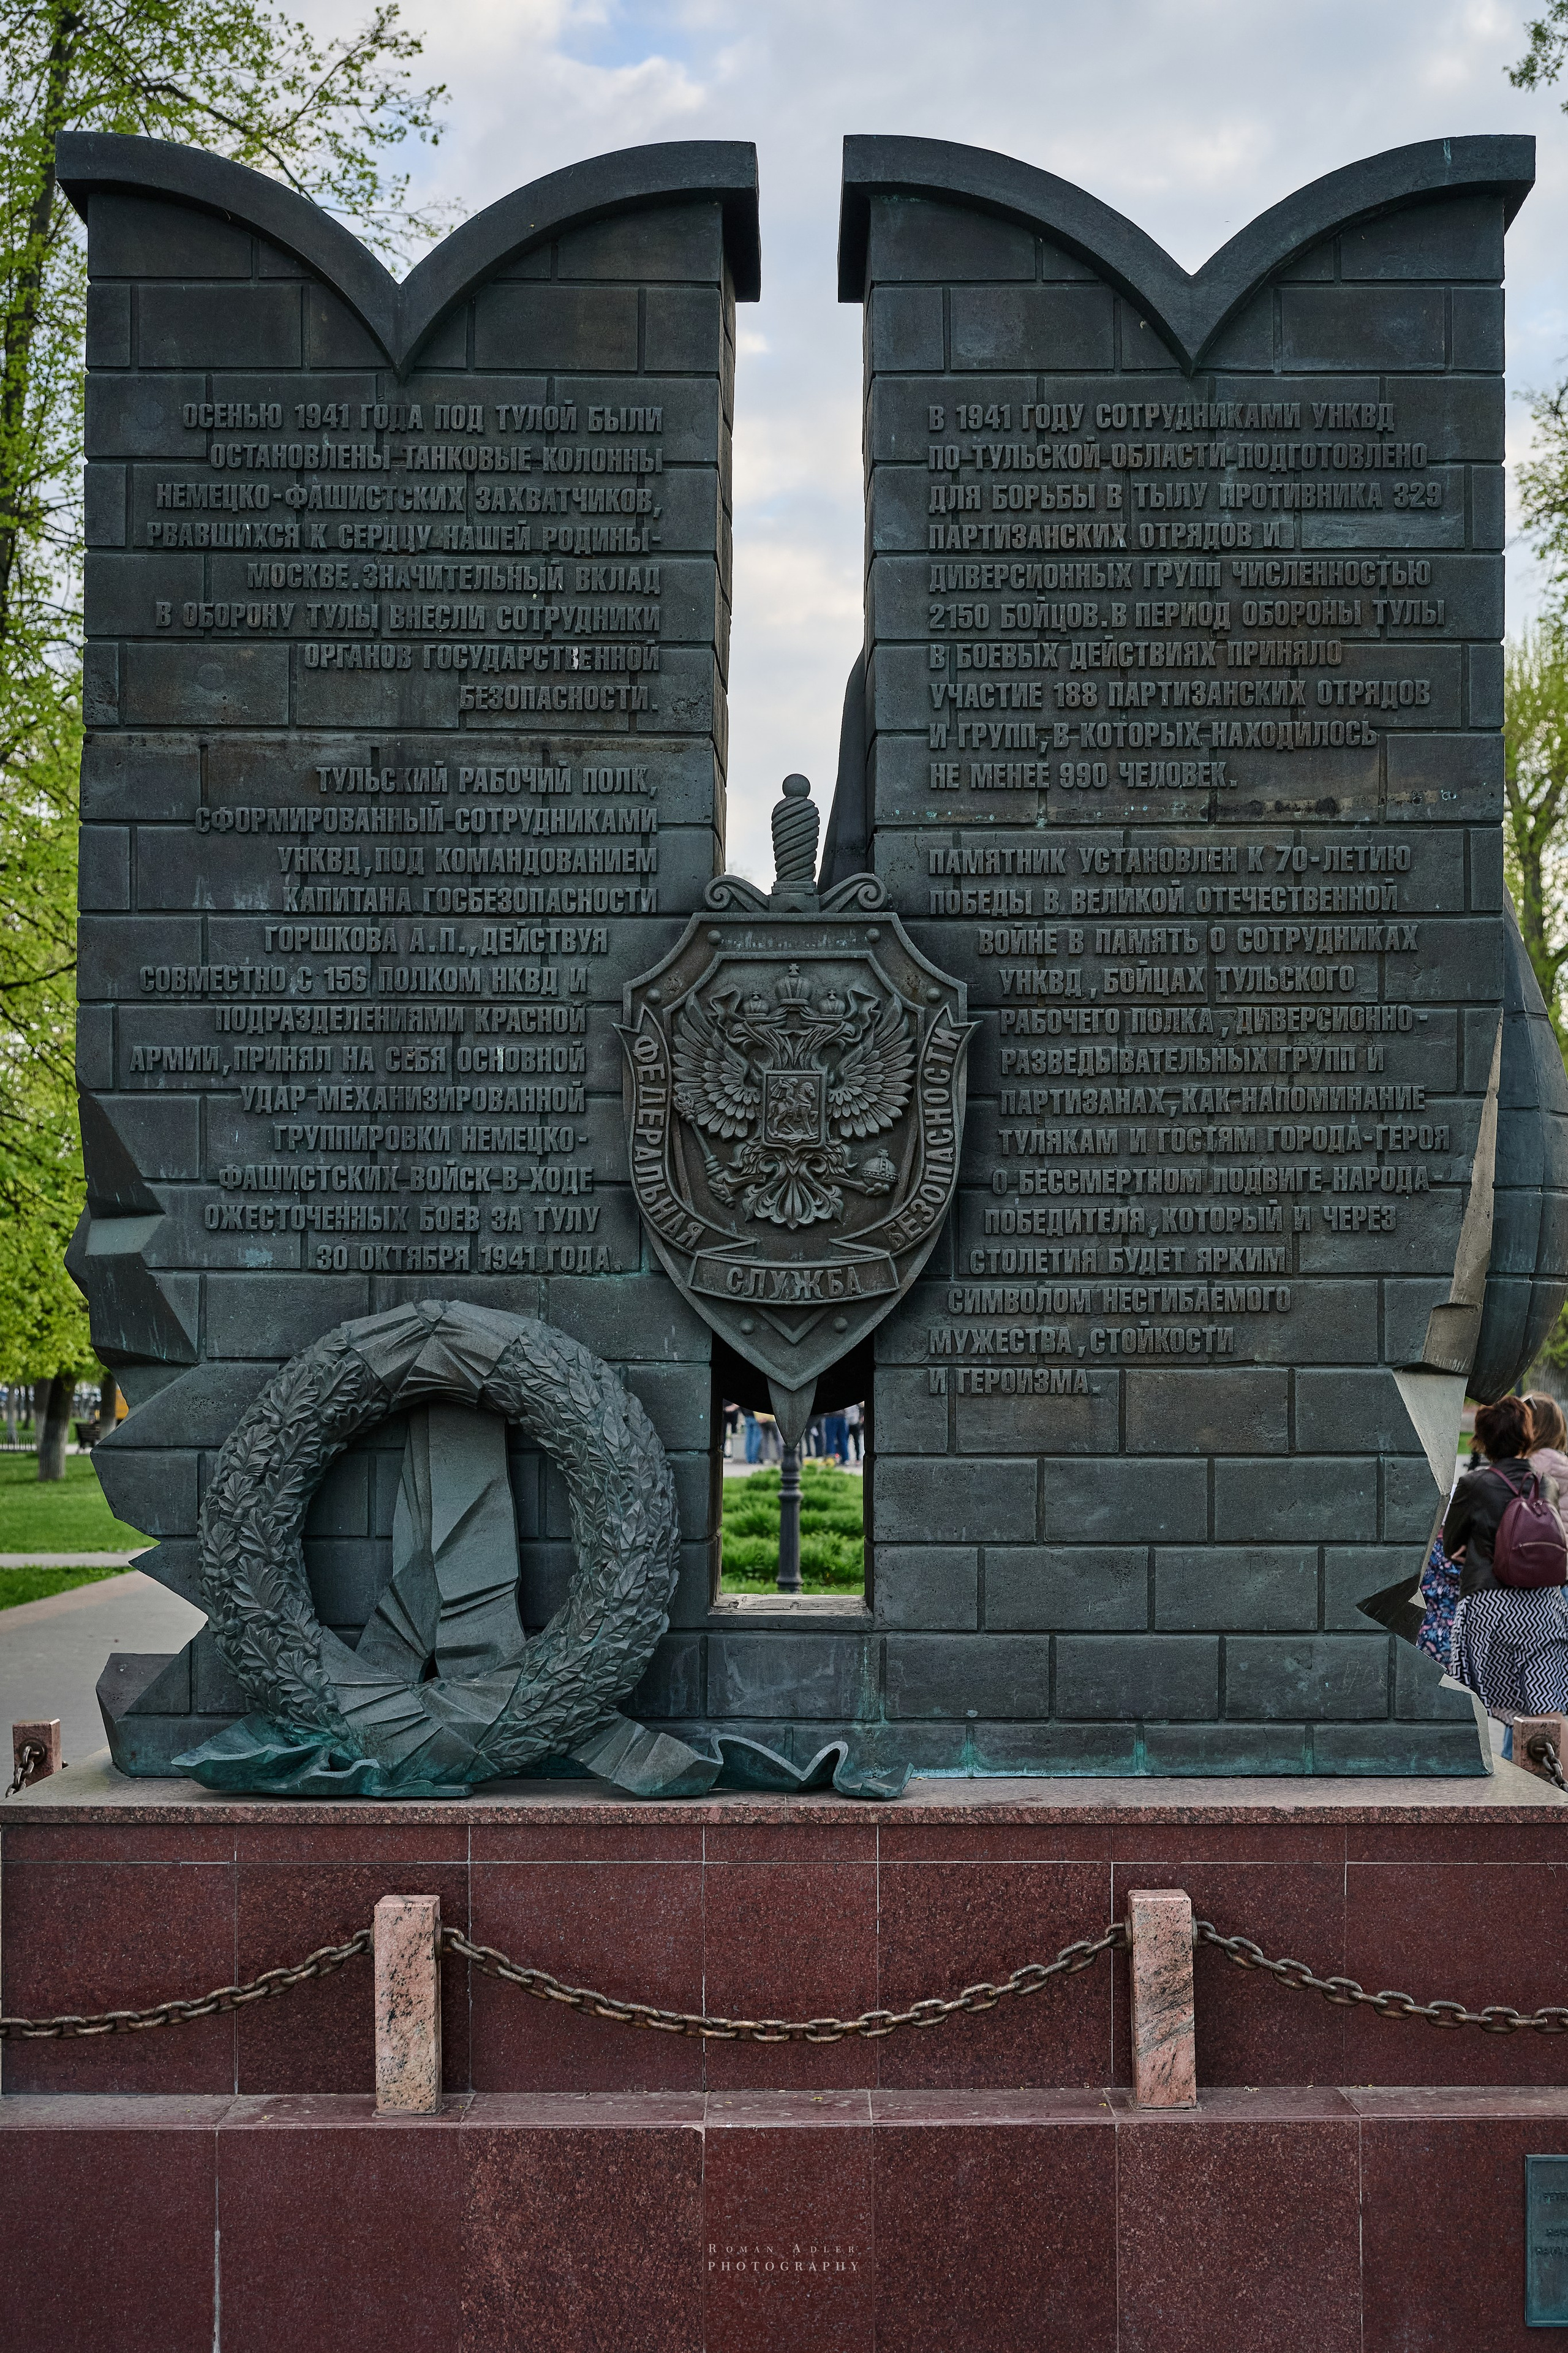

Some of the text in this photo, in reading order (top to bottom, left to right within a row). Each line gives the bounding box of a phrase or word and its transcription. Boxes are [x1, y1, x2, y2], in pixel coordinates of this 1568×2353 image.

[183, 399, 663, 434] ОСЕНЬЮ 1941 ГОДА ПОД ТУЛОЙ БЫЛИ
[929, 402, 1395, 432] В 1941 ГОДУ СОТРУДНИКАМИ УНКВД
[211, 444, 663, 474] ОСТАНОВЛЕНЫ ТАНКОВЫЕ КОЛОННЫ
[929, 437, 1427, 472] ПО ТУЛЬСКОЙ ОБЛАСТИ ПОДГОТОВЛЕНО
[476, 487, 662, 519] ЗАХВАТЧИКОВ,
[929, 482, 1442, 515] ДЛЯ БОРЬБЫ В ТЫЛУ ПРОТИВНИКА 329
[147, 522, 301, 549] РВАВШИХСЯ
[311, 523, 326, 549] К
[338, 523, 432, 554] СЕРДЦУ
[443, 520, 531, 551] НАШЕЙ
[929, 523, 1281, 551] ПАРТИЗАНСКИХ ОТРЯДОВ И
[363, 560, 564, 592] ЗНАЧИТЕЛЬНЫЙ
[576, 567, 661, 595] ВКЛАД
[929, 561, 1431, 593] ДИВЕРСИОННЫХ ГРУПП ЧИСЛЕННОСТЬЮ
[156, 601, 660, 634] В ОБОРОНУ ТУЛЫ ВНЕСЛИ СОТРУДНИКИ
[929, 603, 989, 629] 2150
[1112, 602, 1128, 629] В
[1135, 602, 1231, 632] ПЕРИОД
[1243, 600, 1362, 627] ОБОРОНЫ
[1373, 599, 1446, 626] ТУЛЫ
[304, 640, 660, 673] ОРГАНОВ ГОСУДАРСТВЕННОЙ
[929, 636, 1341, 671] В БОЕВЫХ ДЕЙСТВИЯХ ПРИНЯЛО
[460, 684, 658, 711] БЕЗОПАСНОСТИ.
[929, 680, 1430, 711] УЧАСТИЕ 188 ПАРТИЗАНСКИХ ОТРЯДОВ
[929, 723, 946, 750] И
[1054, 722, 1069, 749] В
[1081, 722, 1200, 749] КОТОРЫХ
[1212, 720, 1378, 750] НАХОДИЛОСЬ
[316, 761, 657, 798] ТУЛЬСКИЙ РАБОЧИЙ ПОЛК,
[929, 761, 1237, 790] НЕ МЕНЕЕ 990 ЧЕЛОВЕК.
[195, 801, 658, 836] СФОРМИРОВАННЫЙ СОТРУДНИКАМИ
[375, 847, 424, 876] ПОД
[435, 846, 658, 876] КОМАНДОВАНИЕМ
[929, 845, 1411, 876] ПАМЯТНИК УСТАНОВЛЕН К 70-ЛЕТИЮ
[283, 886, 658, 914] КАПИТАНА ГОСБЕЗОПАСНОСТИ
[929, 878, 1398, 918] ПОБЕДЫ В ВЕЛИКОЙ ОТЕЧЕСТВЕННОЙ
[265, 926, 396, 953] ГОРШКОВА
[481, 921, 608, 956] ДЕЙСТВУЯ
[979, 923, 1418, 956] ВОЙНЕ В ПАМЯТЬ О СОТРУДНИКАХ
[139, 965, 588, 996] СОВМЕСТНО С 156 ПОЛКОМ НКВД И
[1104, 961, 1205, 997] БОЙЦАХ
[1215, 965, 1355, 994] ТУЛЬСКОГО
[216, 1000, 587, 1034] ПОДРАЗДЕЛЕНИЯМИ КРАСНОЙ
[1000, 1007, 1120, 1035] РАБОЧЕГО
[233, 1046, 331, 1073] ПРИНЯЛ
[342, 1046, 374, 1073] НА
[385, 1046, 446, 1073] СЕБЯ
[457, 1041, 586, 1073] ОСНОВНОЙ
[1001, 1045, 1384, 1078] РАЗВЕДЫВАТЕЛЬНЫХ ГРУПП И
[241, 1081, 586, 1115] УДАР МЕХАНИЗИРОВАННОЙ
[1182, 1087, 1231, 1113] КАК
[1242, 1086, 1425, 1112] НАПОМИНАНИЕ
[274, 1125, 451, 1152] ГРУППИРОВКИ
[631, 1035, 706, 1250] ФЕДЕРАЛЬНАЯ
[883, 1026, 962, 1250] БЕЗОПАСНОСТИ
[999, 1128, 1118, 1156] ТУЛЯКАМ
[1130, 1128, 1147, 1155] И
[1158, 1128, 1256, 1155] ГОСТЯМ
[219, 1161, 594, 1195] ФАШИСТСКИХ ВОЙСК В ХОДЕ
[992, 1165, 1428, 1195] О БЕССМЕРТНОМ ПОДВИГЕ НАРОДА
[205, 1205, 601, 1233] ОЖЕСТОЧЕННЫХ БОЕВ ЗА ТУЛУ
[1163, 1199, 1283, 1233] КОТОРЫЙ
[1293, 1206, 1311, 1232] И
[1322, 1205, 1396, 1231] ЧЕРЕЗ
[316, 1245, 347, 1271] 30
[360, 1245, 469, 1272] ОКТЯБРЯ
[481, 1245, 537, 1272] 1941
[970, 1247, 1286, 1275] СТОЛЕТИЯ БУДЕТ ЯРКИМ
[726, 1266, 859, 1299] СЛУЖБА
[948, 1286, 1292, 1315] СИМВОЛОМ НЕСГИБАЕМОГО
[1090, 1321, 1234, 1354] СТОЙКОСТИ
[929, 1368, 946, 1394] И
